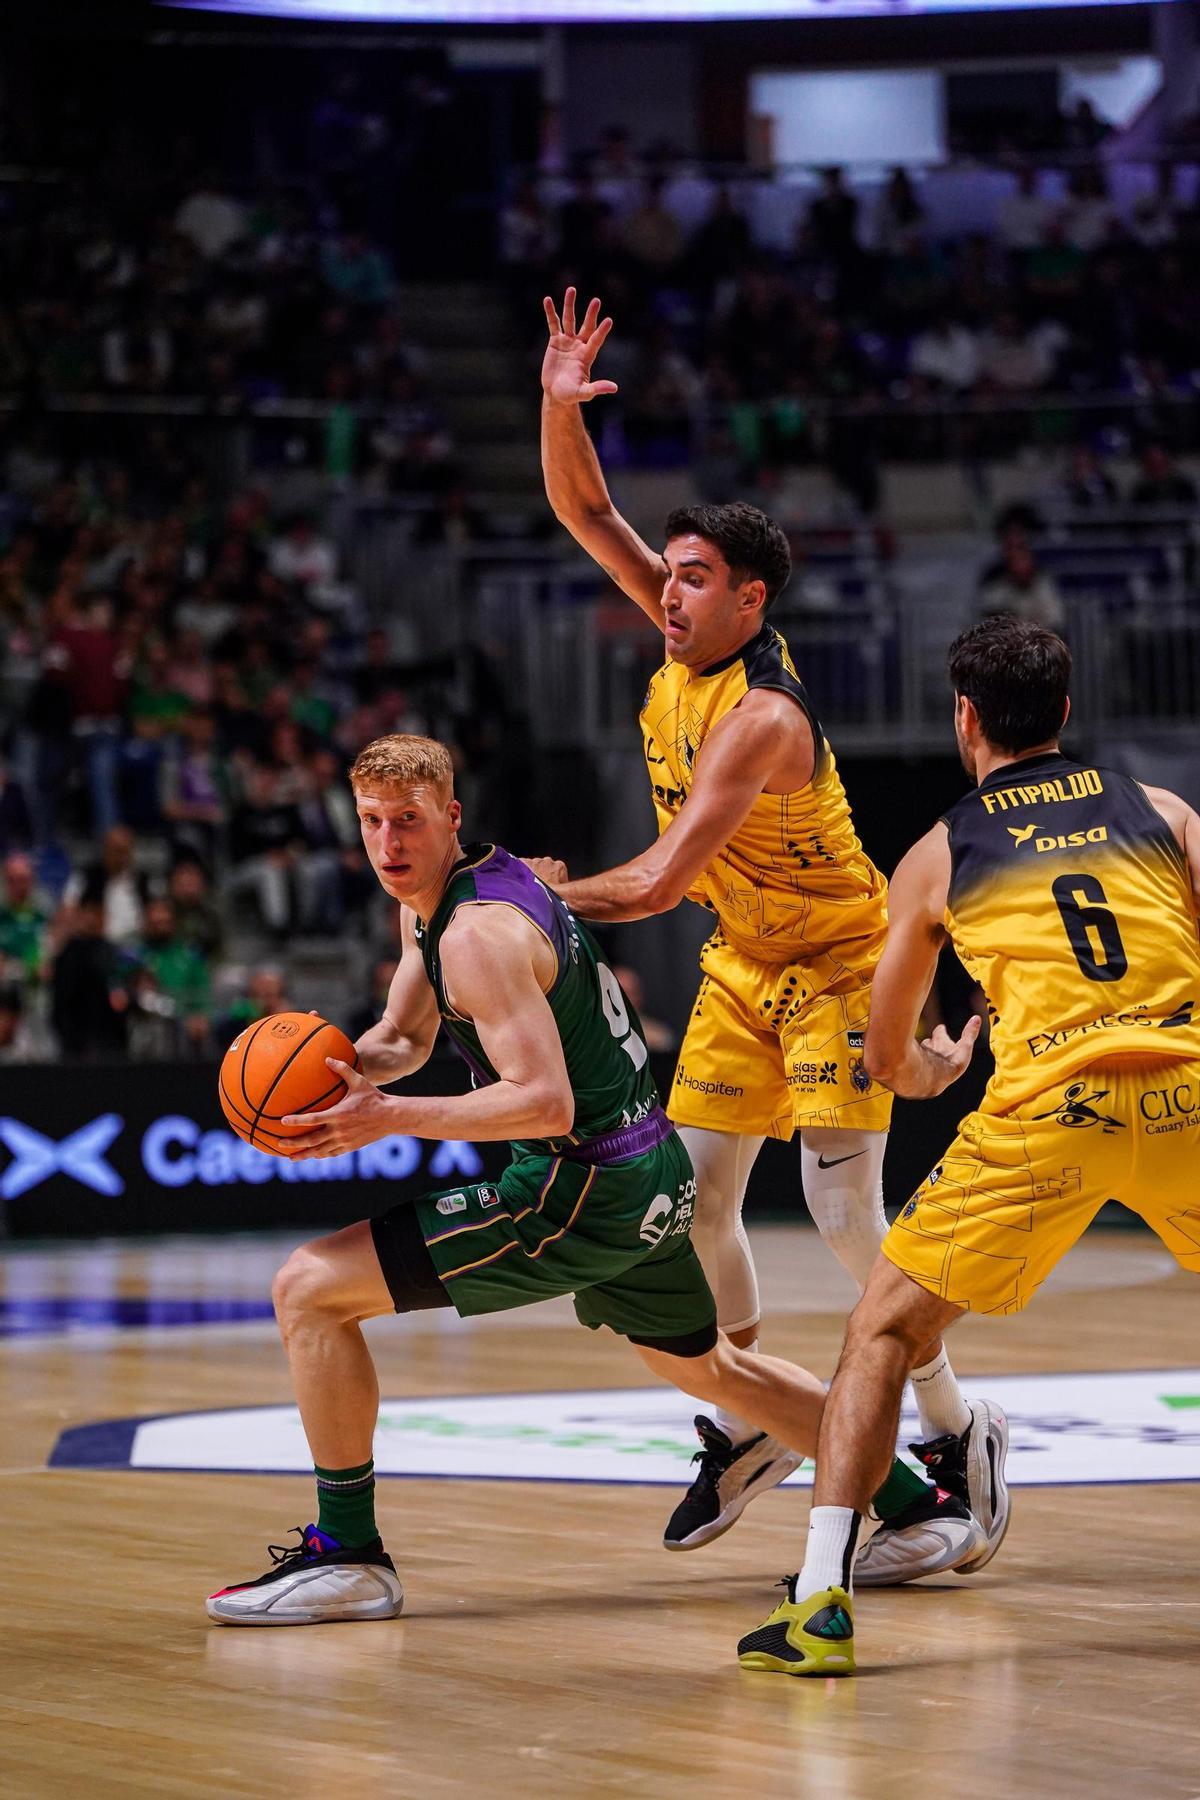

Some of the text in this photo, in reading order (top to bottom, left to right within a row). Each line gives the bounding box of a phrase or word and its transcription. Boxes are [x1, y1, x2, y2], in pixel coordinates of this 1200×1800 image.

[981, 769, 1104, 815] FITIPALDO
[1051, 873, 1128, 983] 6
[683, 1075, 744, 1097] Hospiten
[1140, 1084, 1200, 1121] CIC
[1145, 1121, 1185, 1135] Canary
